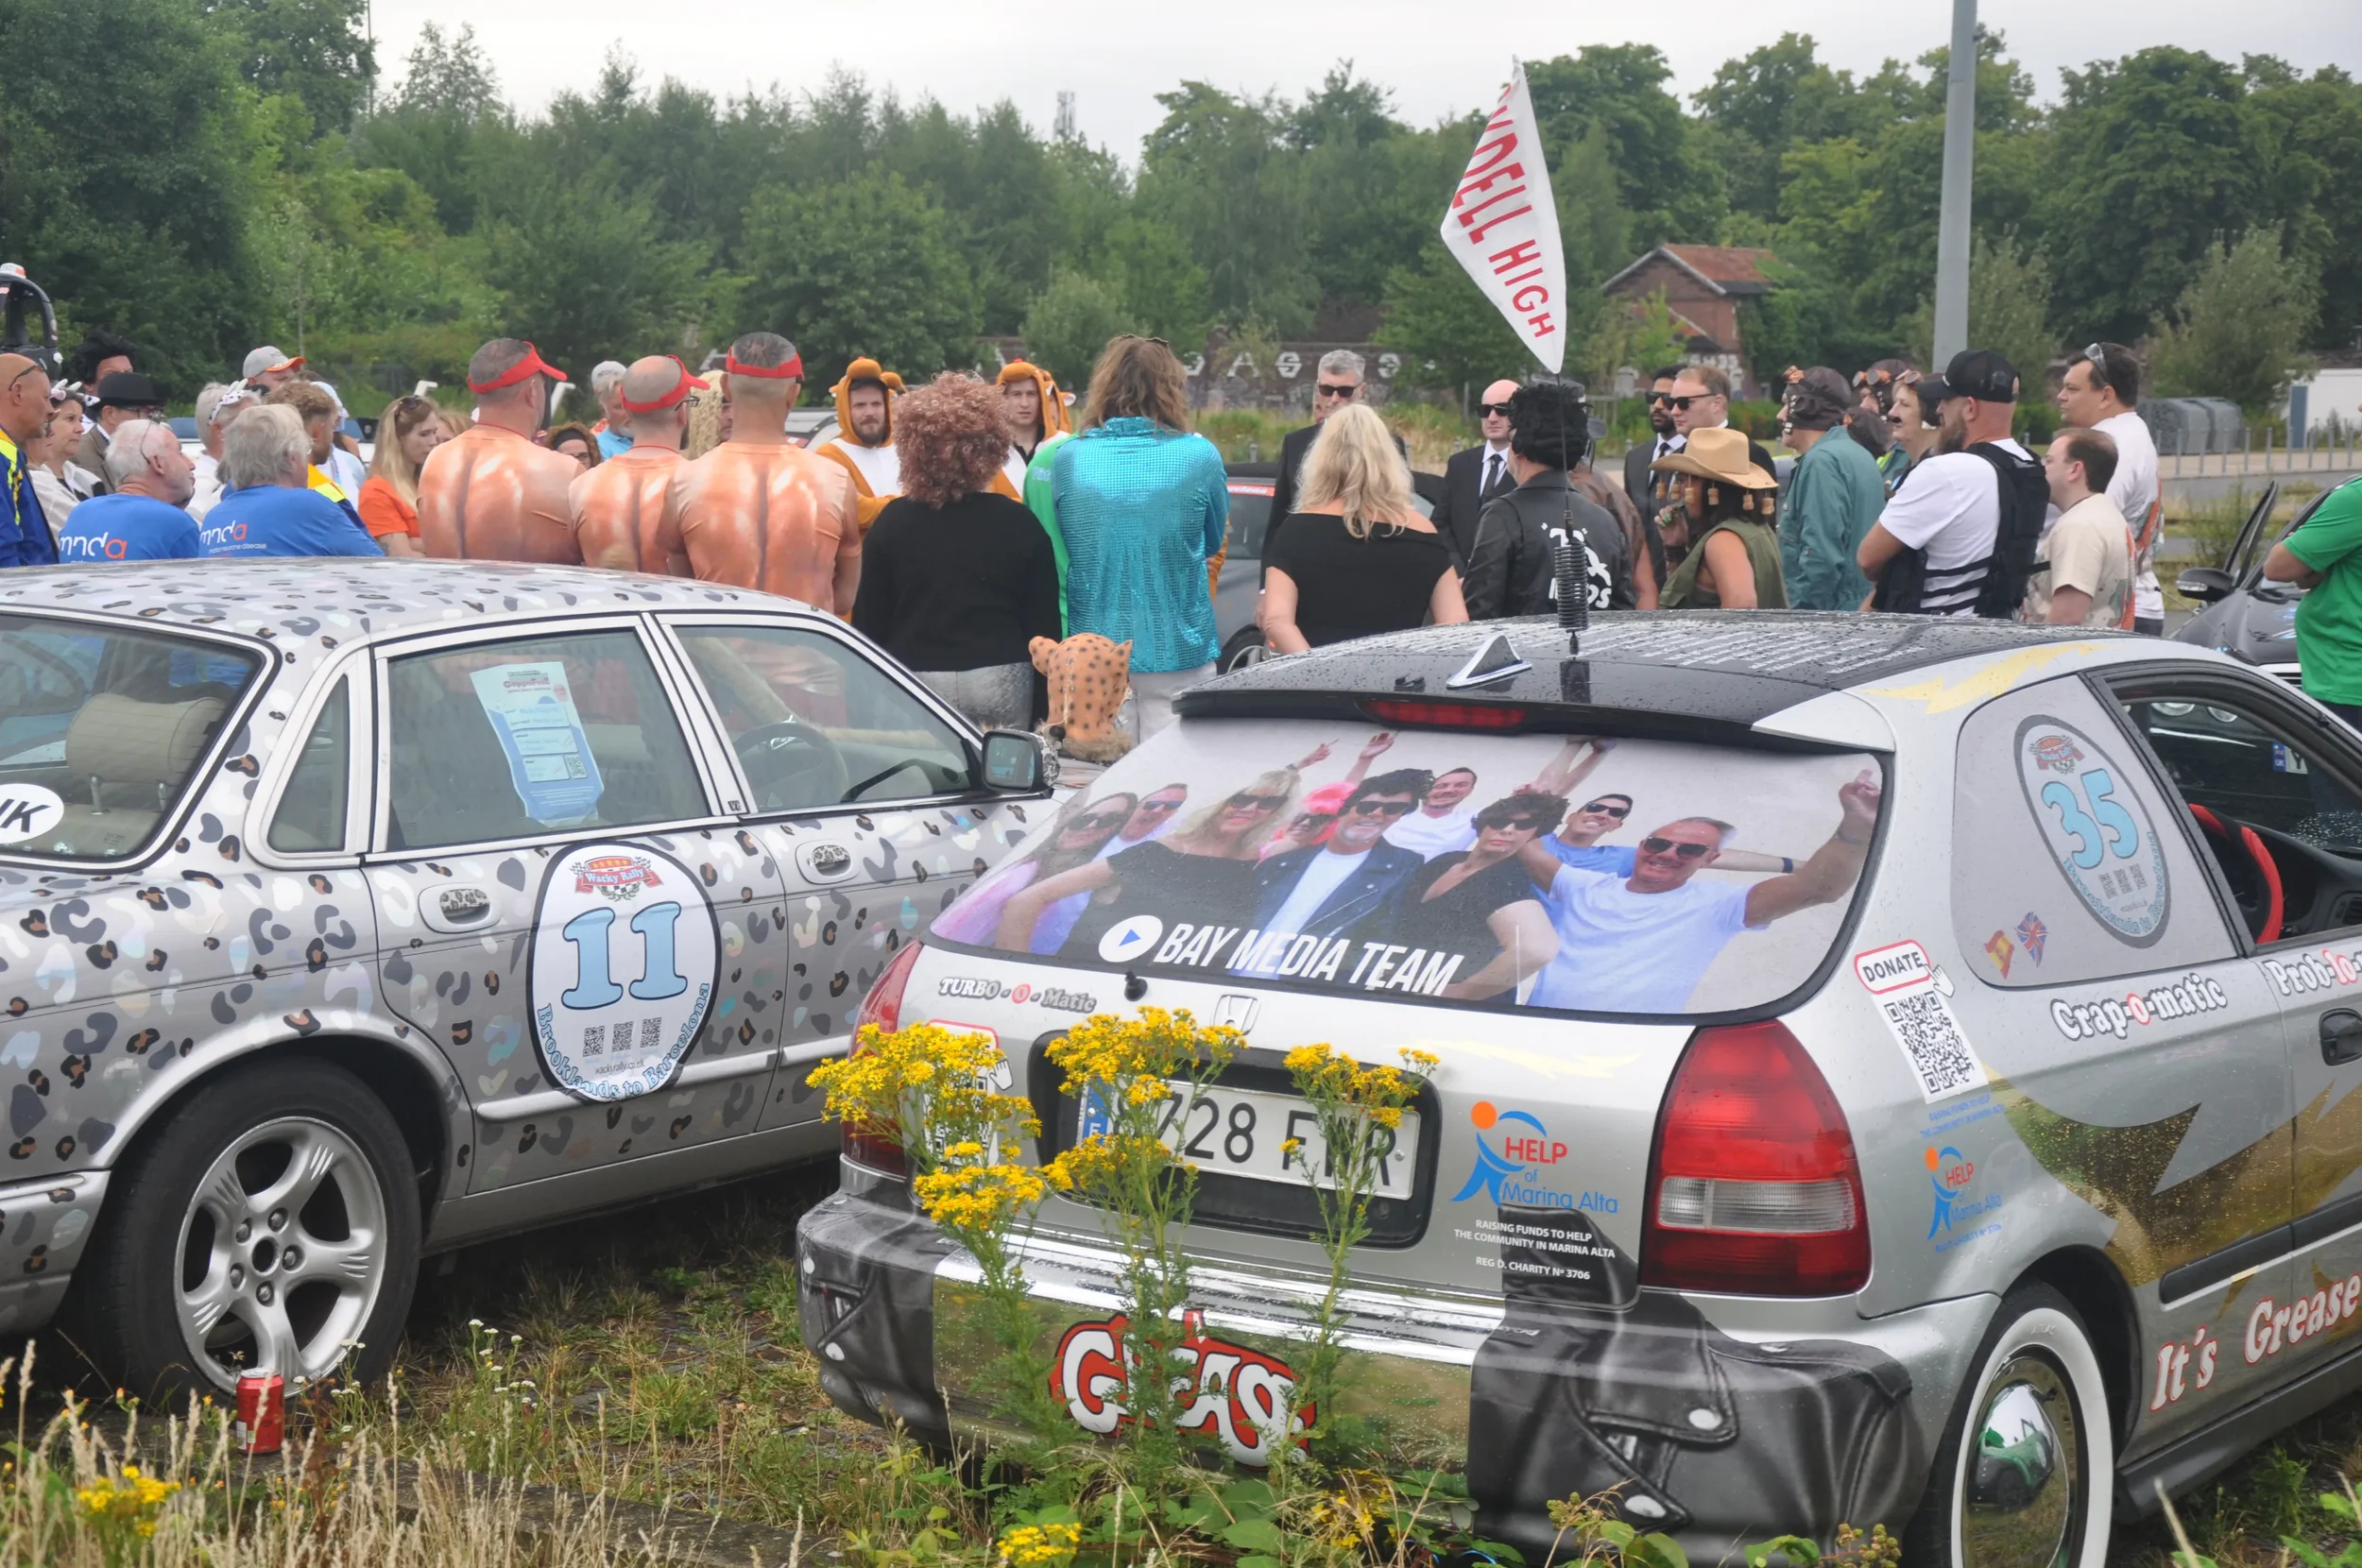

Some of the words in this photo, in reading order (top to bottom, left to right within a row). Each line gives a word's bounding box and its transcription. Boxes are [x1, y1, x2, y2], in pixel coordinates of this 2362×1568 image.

[1488, 239, 1555, 338] HIGH
[199, 520, 248, 546] mnda
[2041, 768, 2139, 870] 35
[586, 871, 618, 885] Wacky
[620, 866, 644, 883] Rally
[561, 901, 688, 1010] 11
[1153, 923, 1240, 969] BAY
[1225, 929, 1351, 982] MEDIA
[1348, 942, 1465, 997] TEAM
[1862, 951, 1925, 982] DONATE
[2051, 973, 2228, 1041] Crap-o-matic
[537, 1003, 620, 1099] Brooklands
[623, 1081, 643, 1098] to
[642, 982, 710, 1090] Barcelona
[1504, 1136, 1568, 1165] HELP
[1524, 1169, 1539, 1183] of
[1945, 1162, 1975, 1188] HELP
[1501, 1183, 1573, 1209] Marina
[1579, 1191, 1618, 1214] Alta
[1454, 1229, 1473, 1239] THE
[1474, 1232, 1534, 1249] COMMUNITY
[1535, 1240, 1547, 1251] IN
[1549, 1242, 1589, 1256] MARINA
[1590, 1247, 1616, 1258] ALTA
[1476, 1219, 1515, 1233] RAISING
[1515, 1223, 1549, 1237] FUNDS
[1550, 1229, 1565, 1239] TO
[1566, 1231, 1592, 1242] HELP
[1476, 1257, 1495, 1268] REG
[1508, 1261, 1550, 1276] CHARITY
[1566, 1269, 1591, 1280] 3706
[2245, 1272, 2362, 1366] Grease
